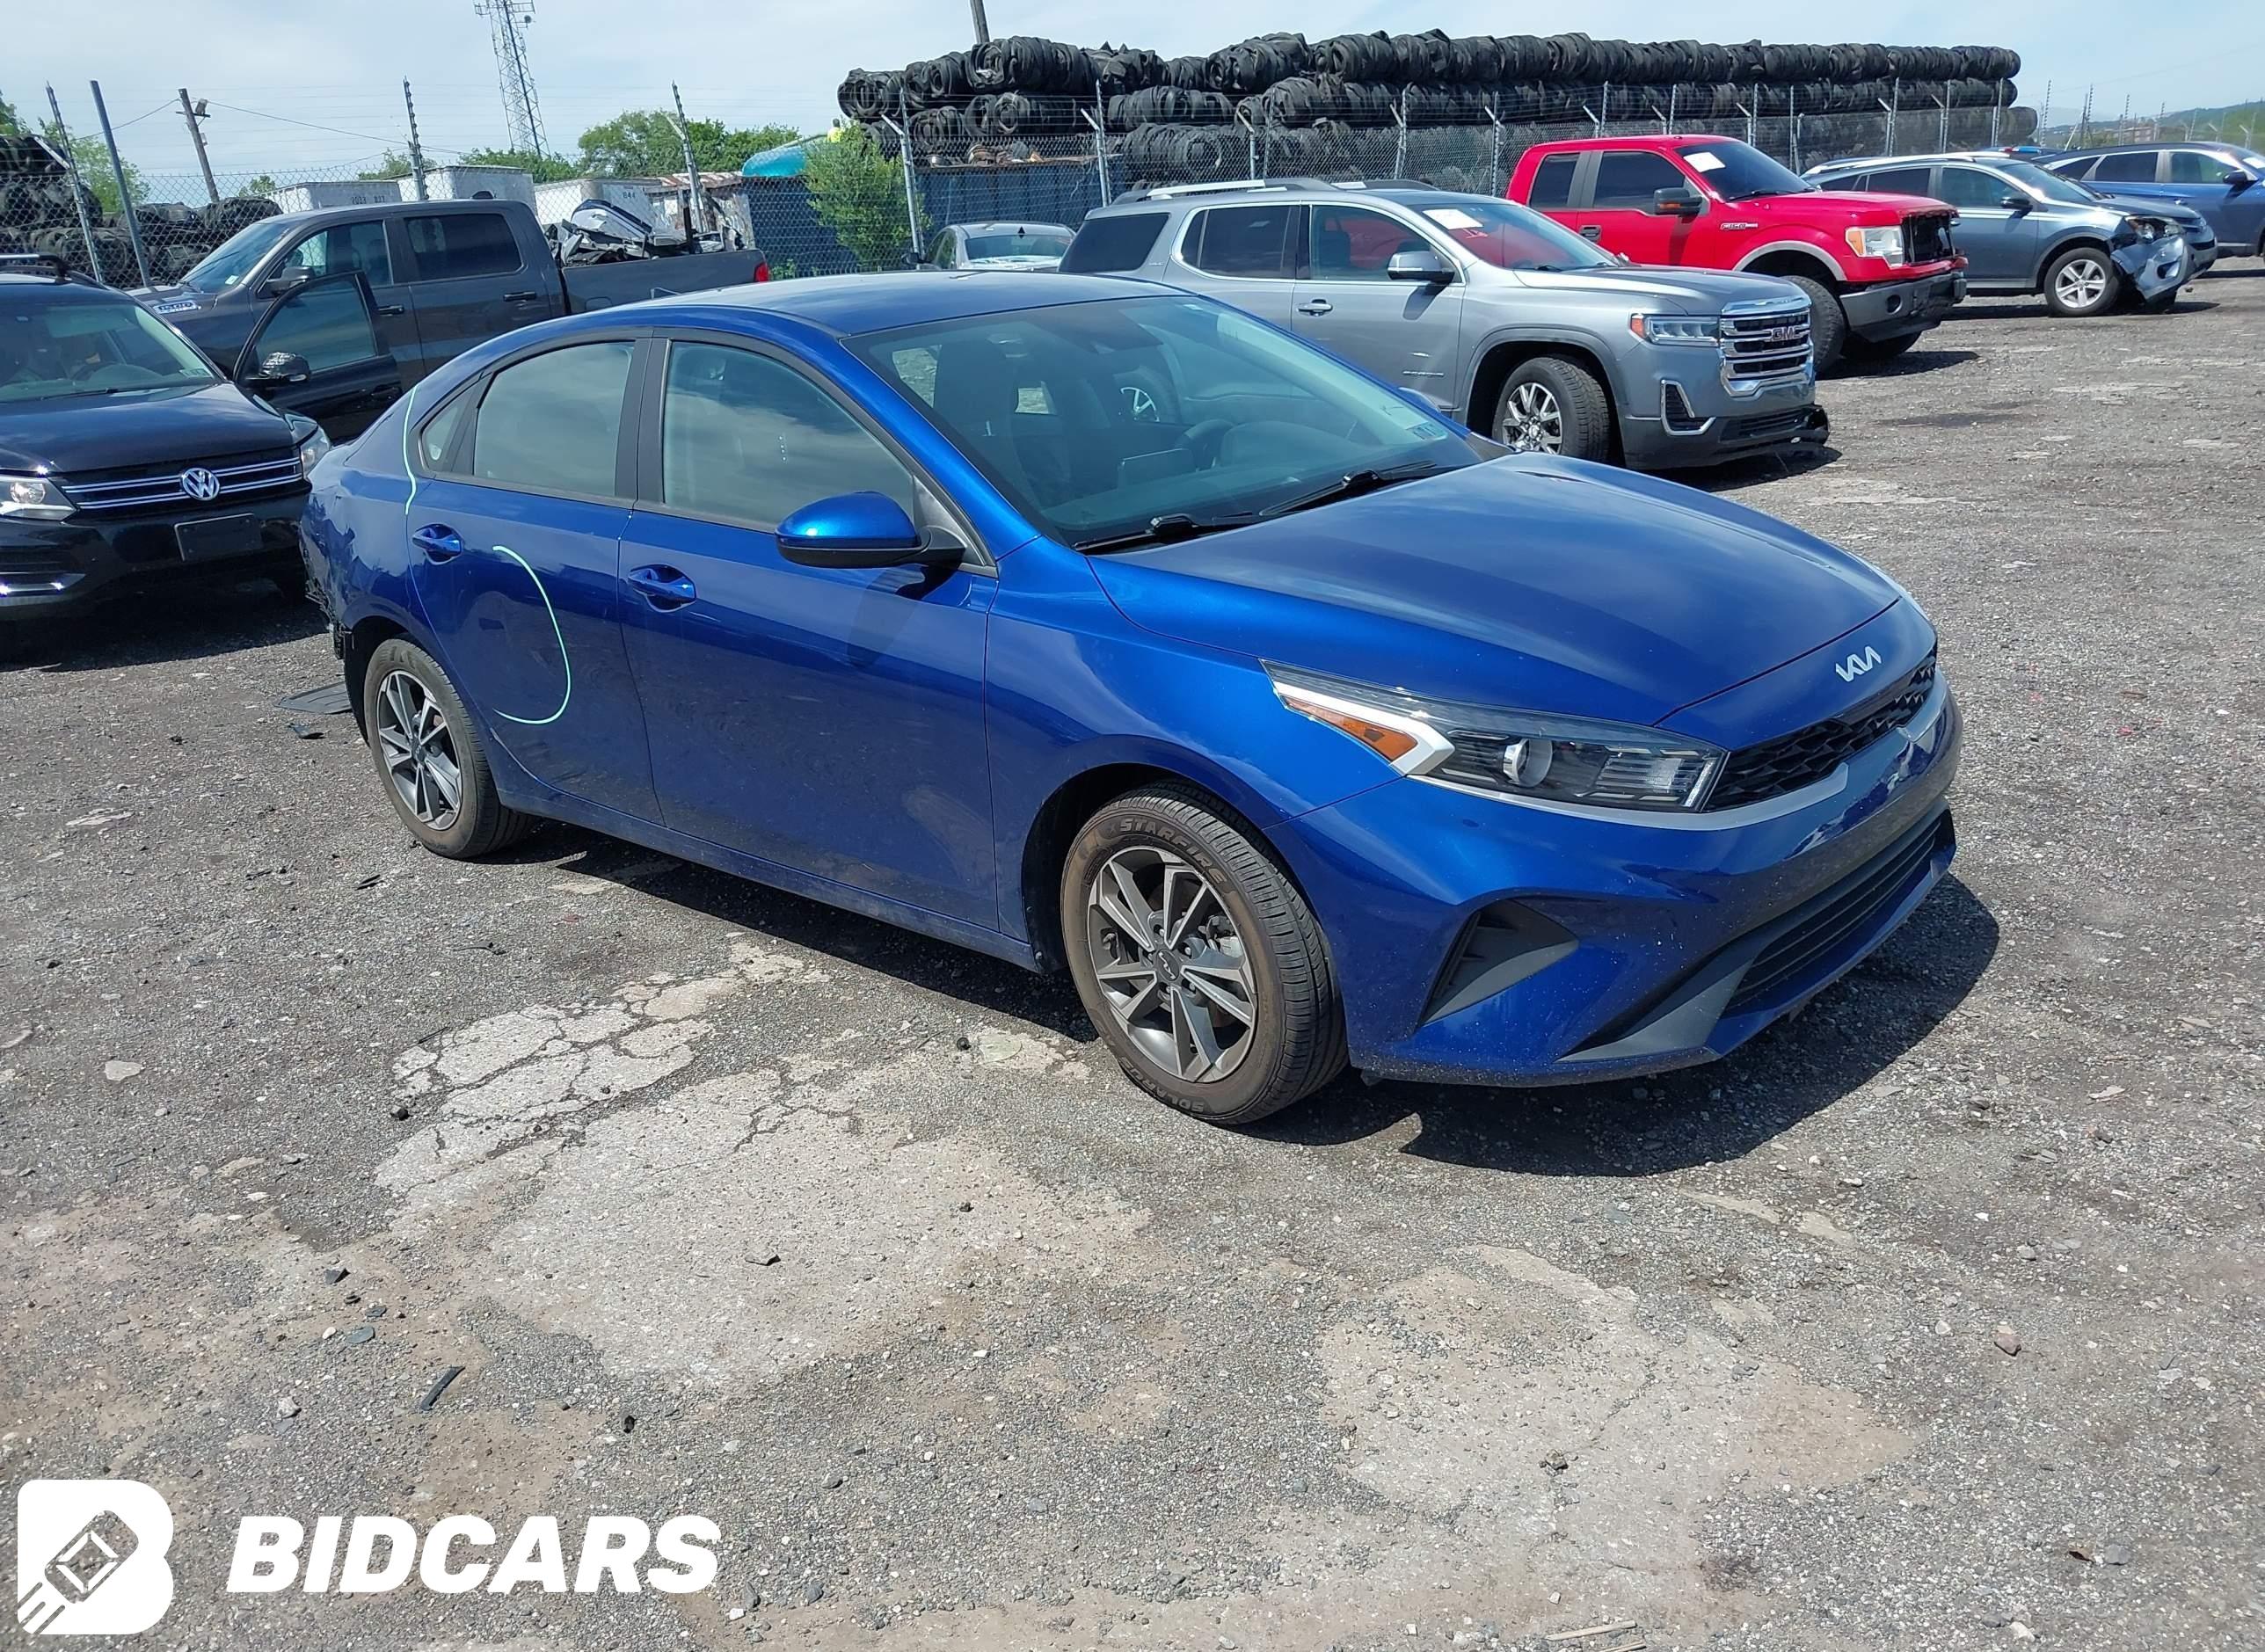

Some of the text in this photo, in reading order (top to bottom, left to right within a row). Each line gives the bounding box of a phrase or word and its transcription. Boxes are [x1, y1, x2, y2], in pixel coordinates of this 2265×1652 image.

[1771, 324, 1810, 342] GMC
[1835, 645, 1882, 682] KIA
[1119, 816, 1227, 884] STARFIRE
